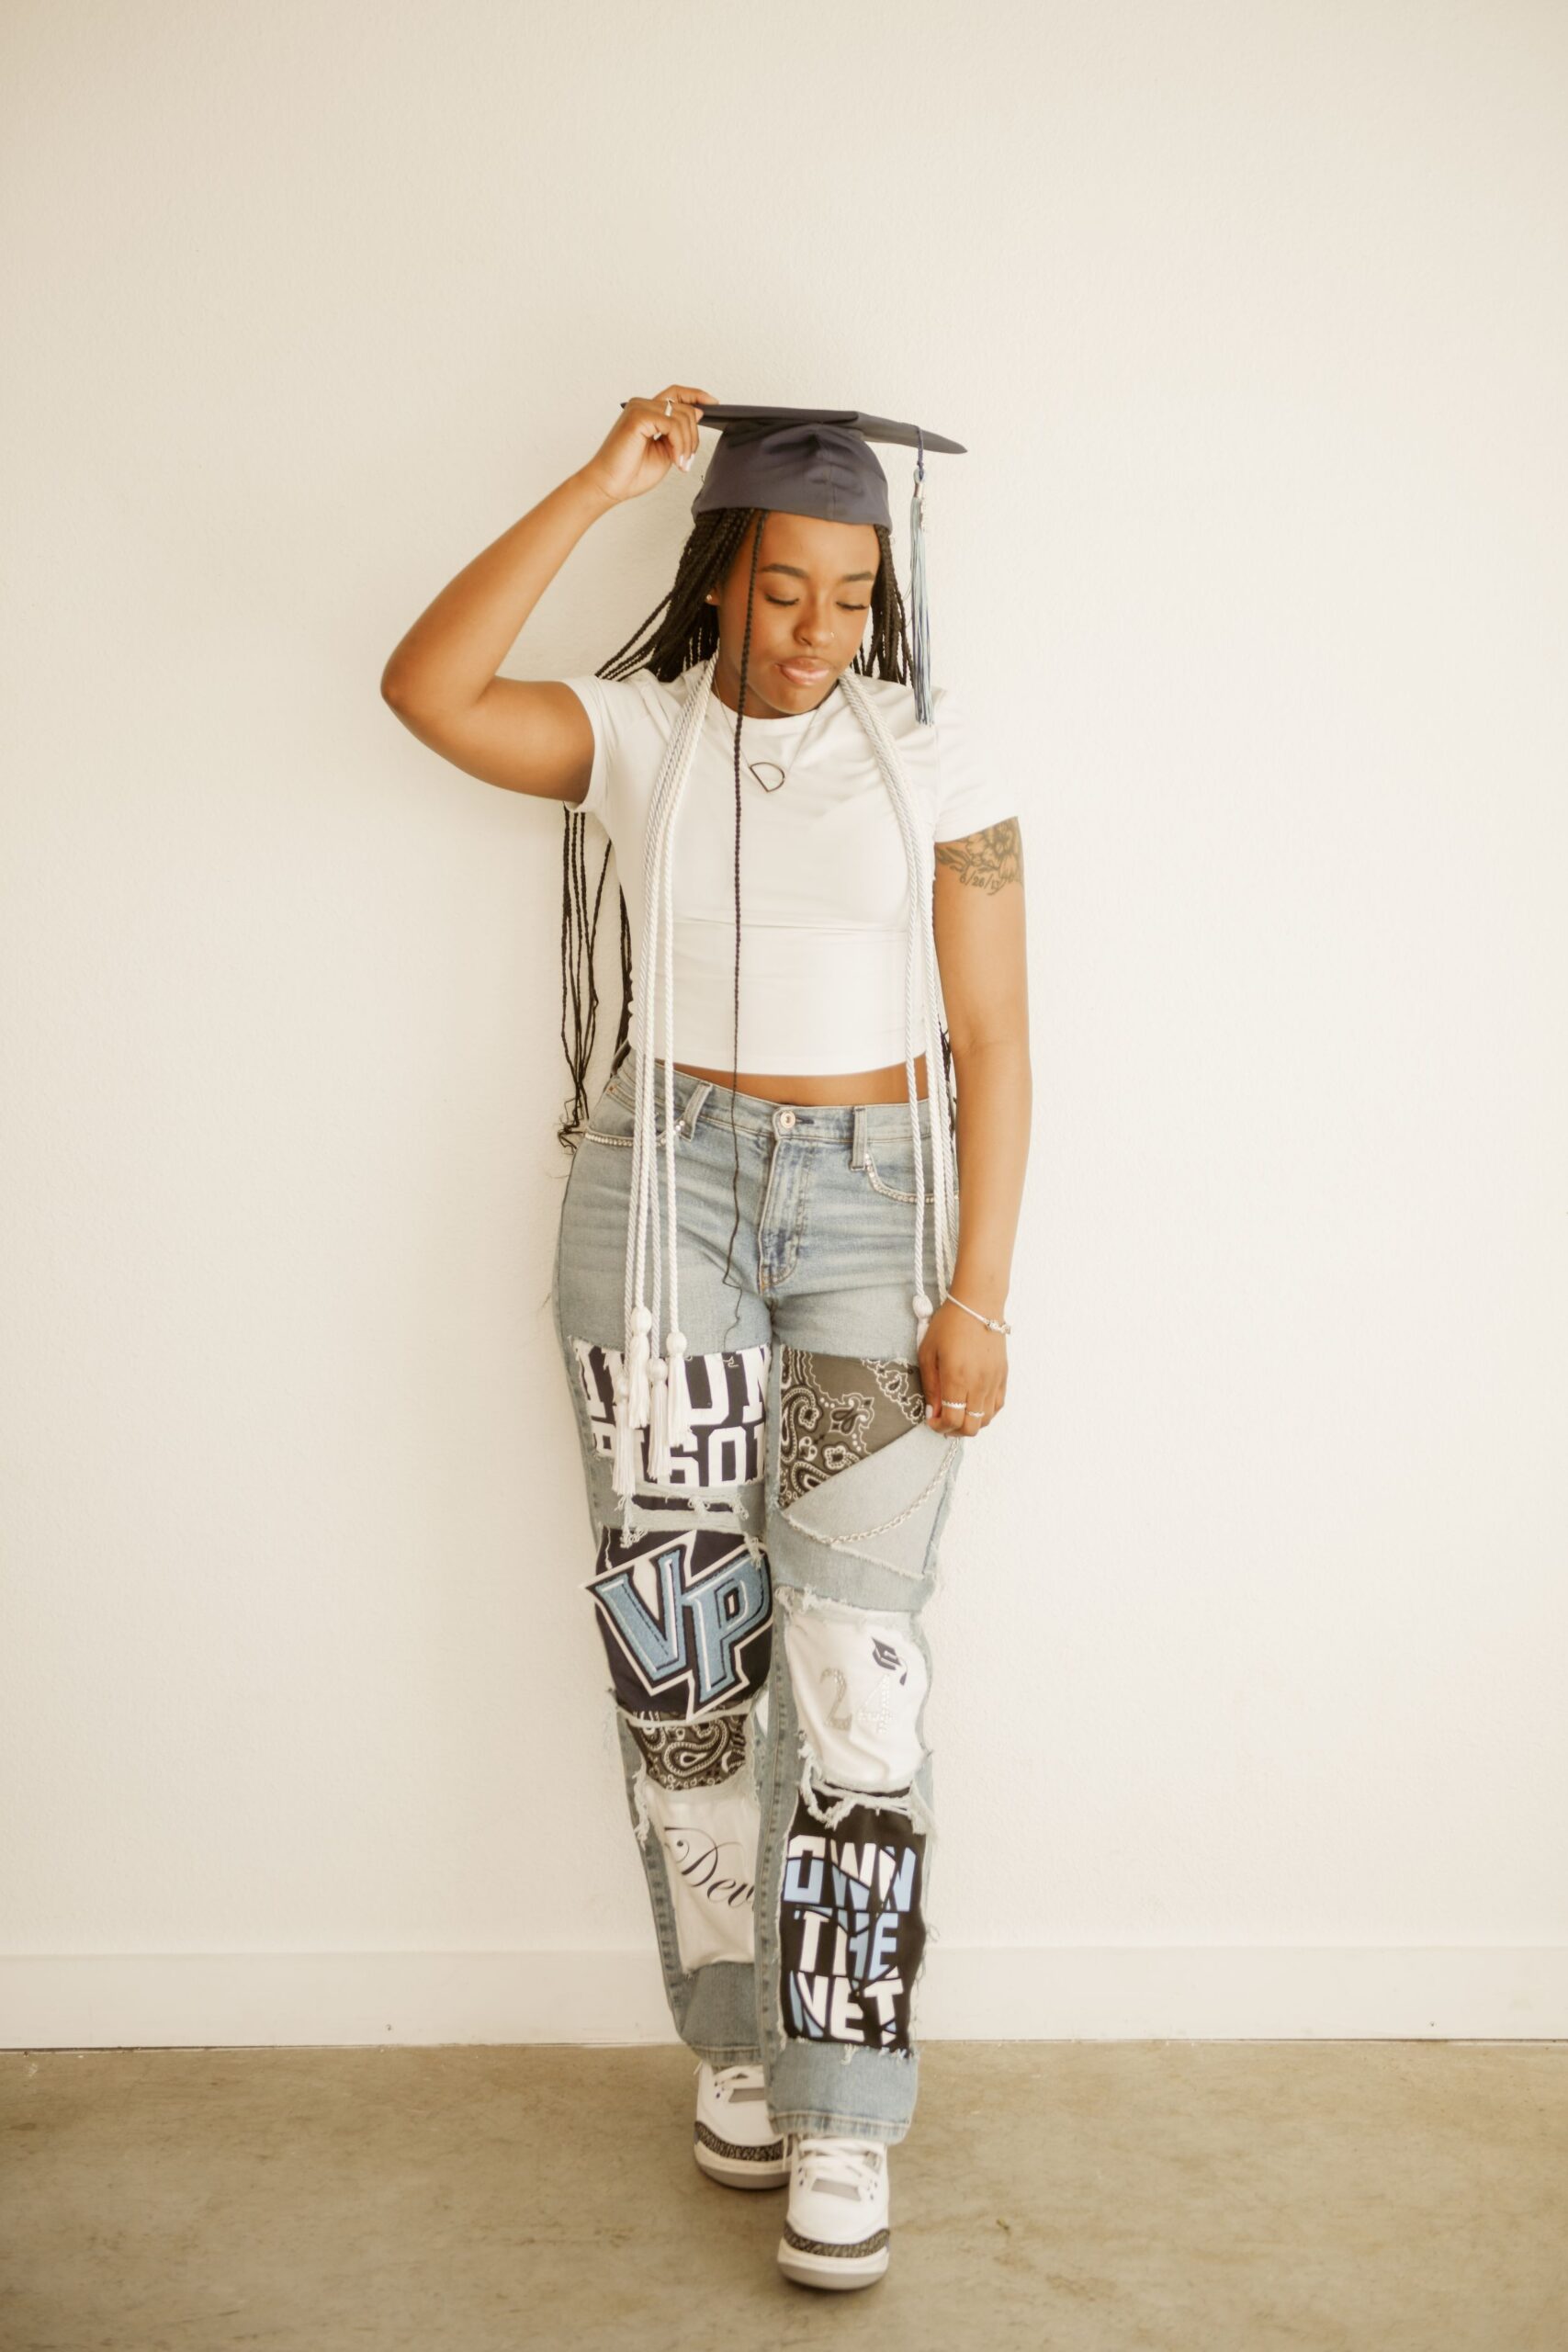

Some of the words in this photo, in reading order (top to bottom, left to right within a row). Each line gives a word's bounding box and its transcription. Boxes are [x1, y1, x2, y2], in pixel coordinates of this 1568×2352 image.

[581, 1529, 774, 1721] VP
[784, 1834, 917, 1912] OWN
[794, 1905, 899, 1982] THE
[789, 1966, 904, 2045] NET
